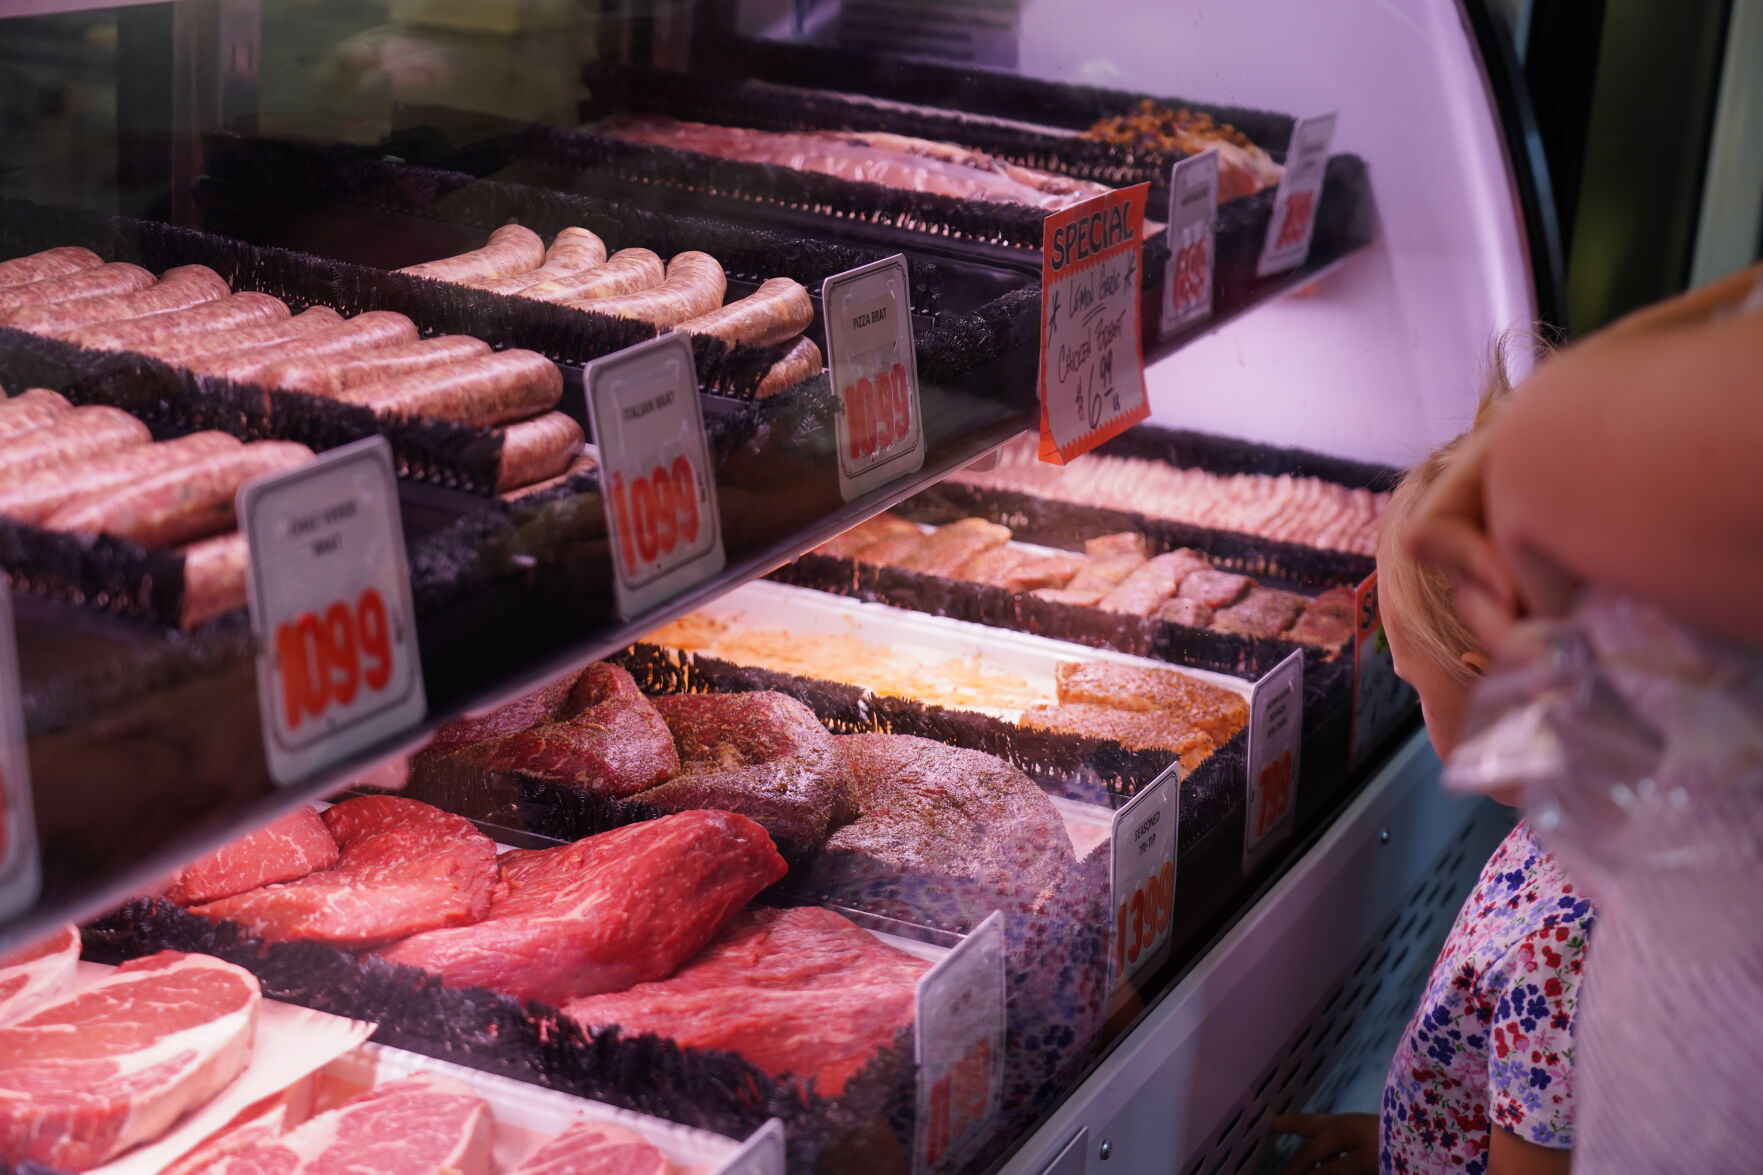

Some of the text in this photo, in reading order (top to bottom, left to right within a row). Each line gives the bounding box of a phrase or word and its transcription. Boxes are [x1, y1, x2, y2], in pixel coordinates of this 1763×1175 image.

[1051, 200, 1134, 271] SPECIAL
[852, 306, 888, 330] PIZZA BRAT
[622, 390, 676, 422] ITALIAN BRAT
[843, 362, 910, 460] 1099
[611, 454, 700, 578] 1099
[274, 587, 394, 731] 1099
[1133, 810, 1161, 843] SEASONED
[1138, 832, 1157, 858] TRI-TIP
[1115, 860, 1174, 979] 1399
